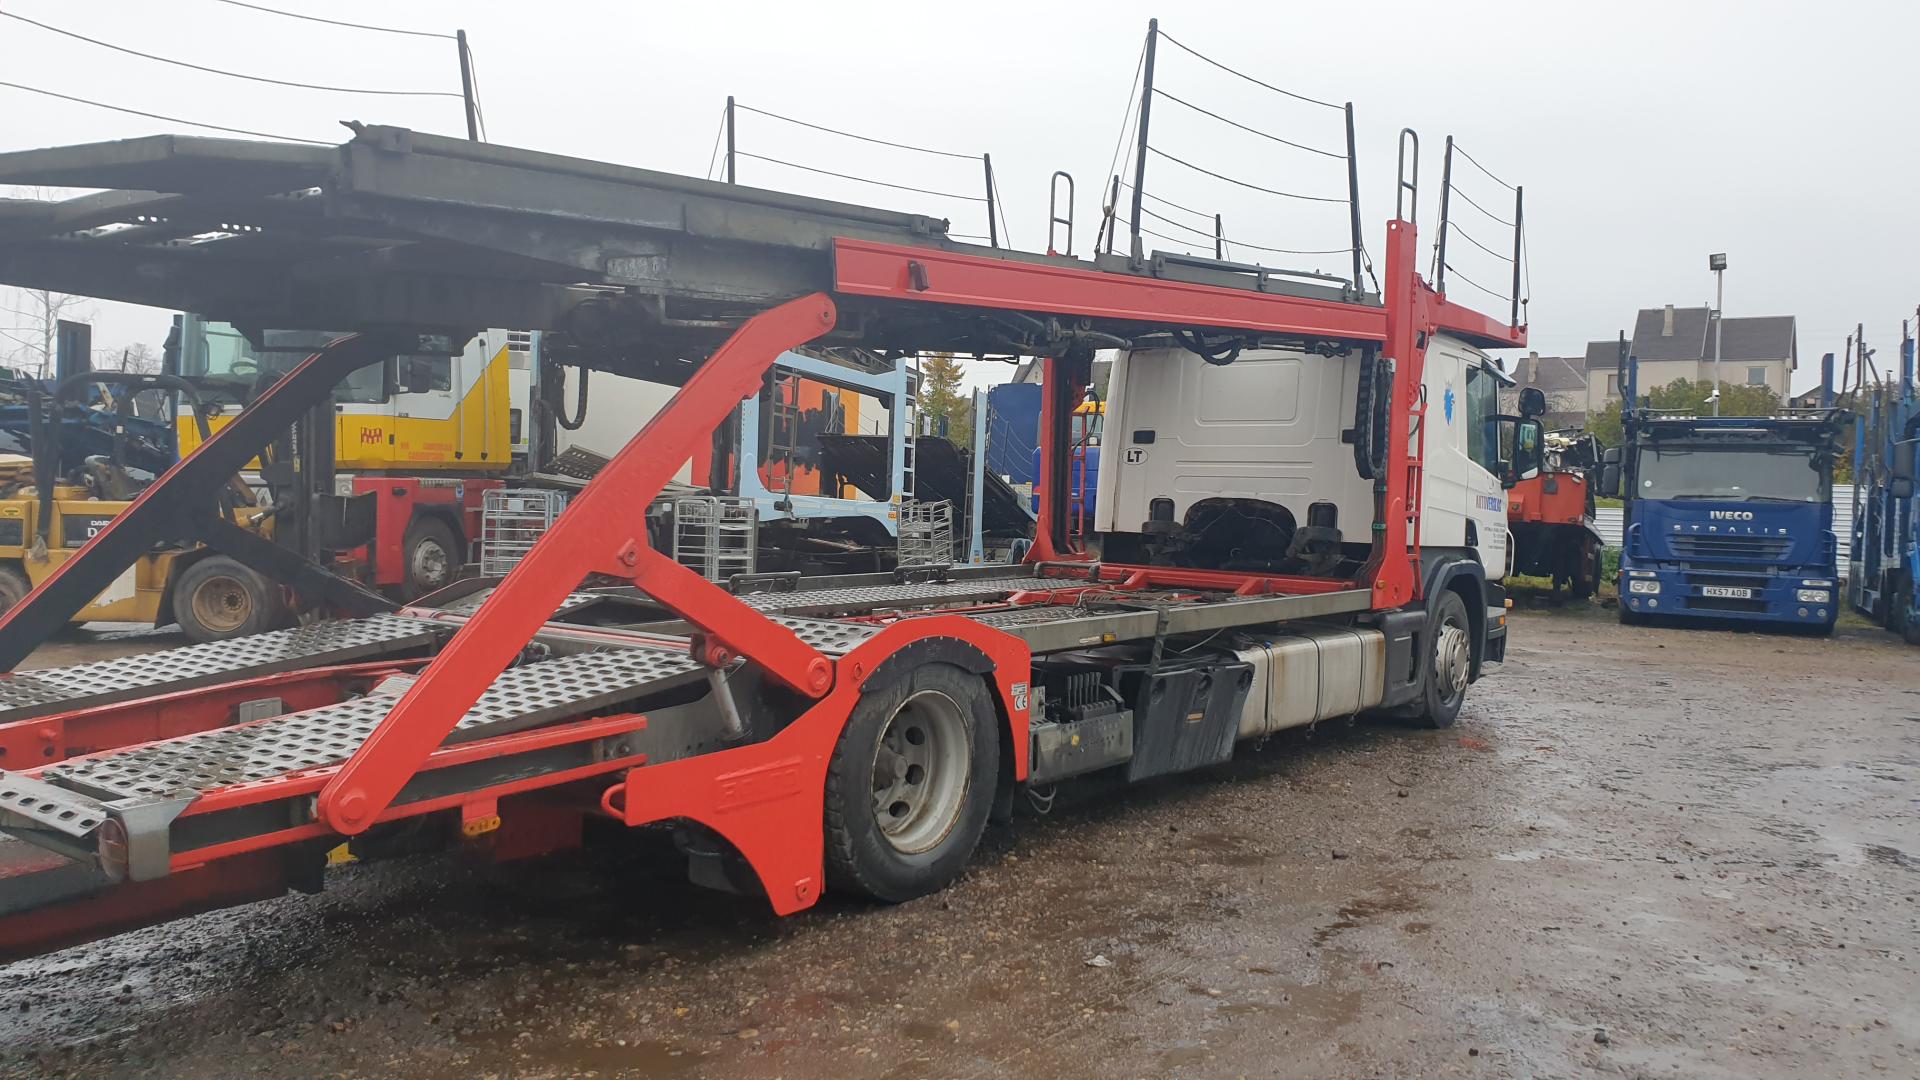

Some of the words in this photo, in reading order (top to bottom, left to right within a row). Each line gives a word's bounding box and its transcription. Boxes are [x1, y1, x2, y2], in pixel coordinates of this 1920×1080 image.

[1127, 451, 1142, 462] LT
[1710, 511, 1753, 520] IVECO
[1673, 525, 1787, 534] STRALIS
[1706, 588, 1729, 596] HX57
